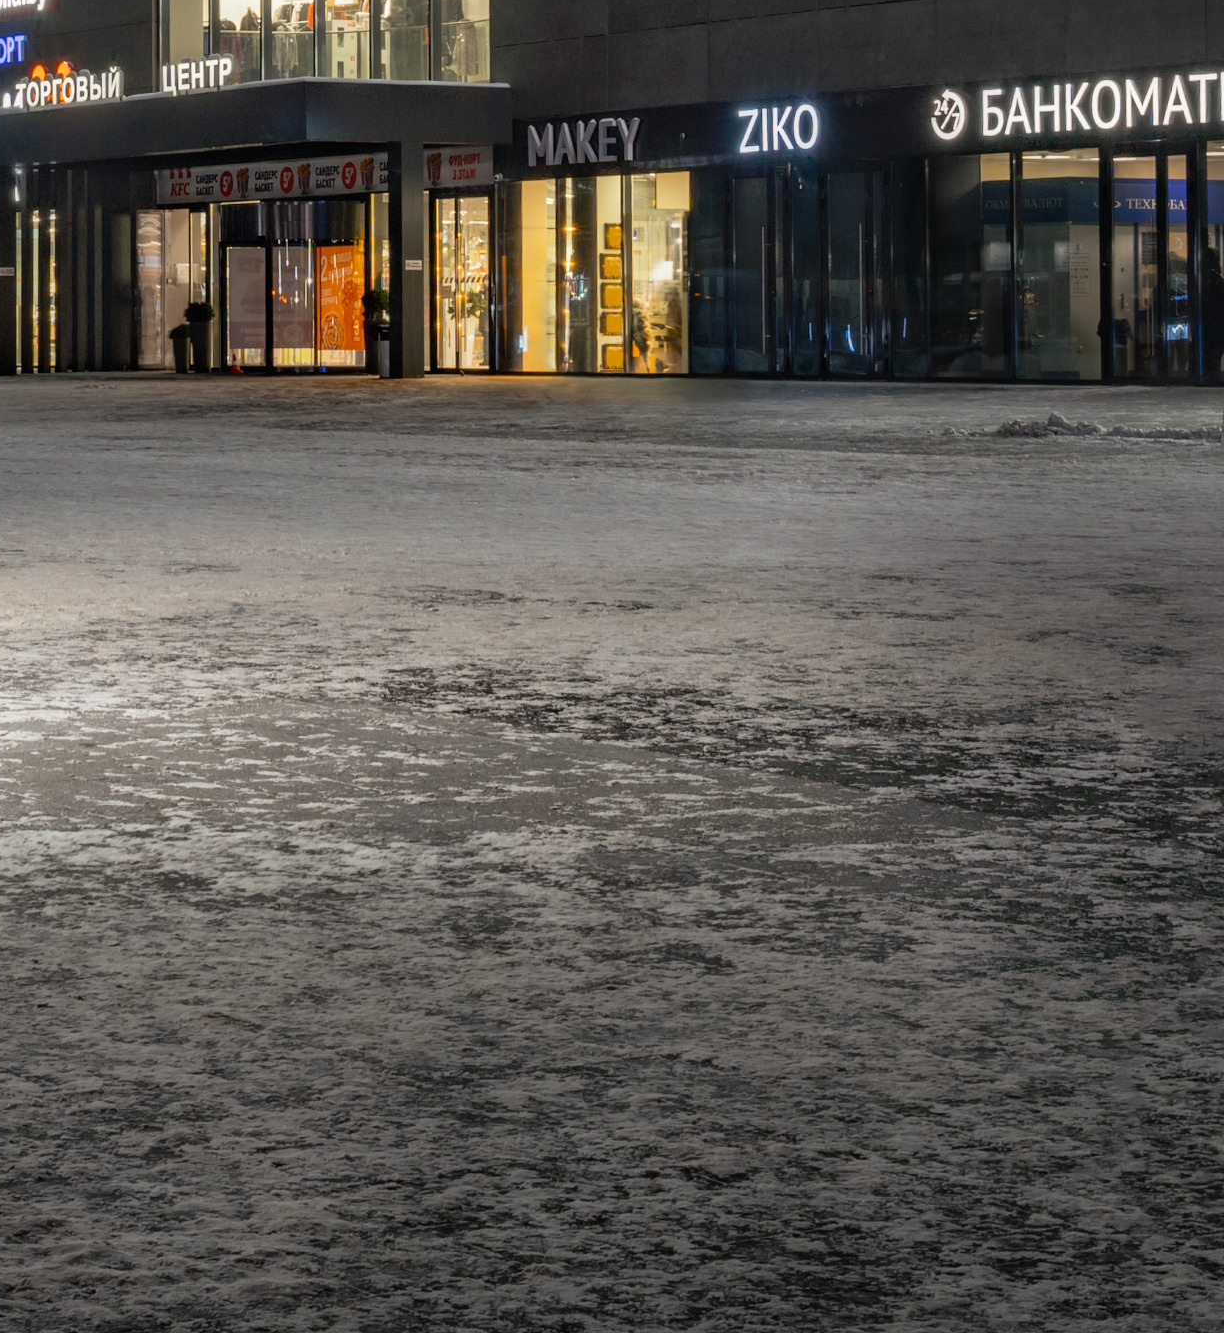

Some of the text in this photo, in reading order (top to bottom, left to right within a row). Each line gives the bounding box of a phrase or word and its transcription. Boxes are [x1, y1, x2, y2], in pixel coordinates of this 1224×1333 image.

[15, 58, 233, 109] ТОРГОВЫЙ ЦЕНТР
[982, 72, 1224, 137] БАНКОМАТ
[738, 104, 819, 153] ZIKO
[933, 99, 961, 132] 24/7
[527, 116, 640, 167] MAKEY
[170, 182, 191, 197] KFC
